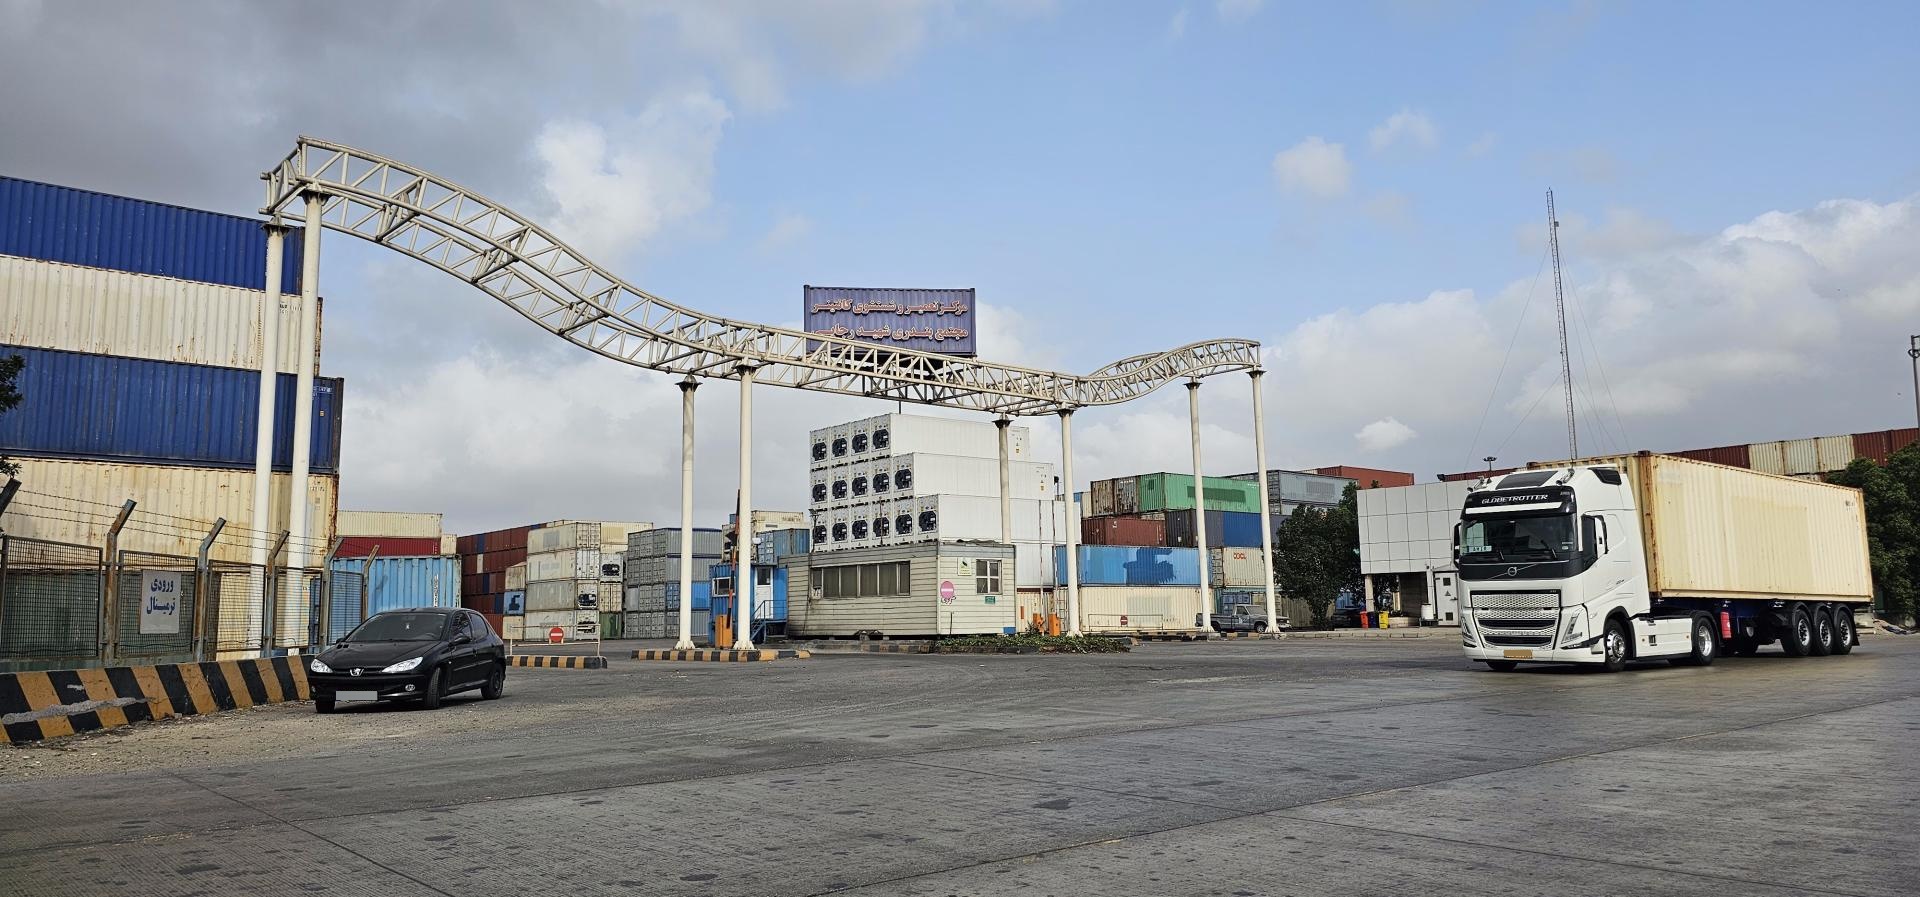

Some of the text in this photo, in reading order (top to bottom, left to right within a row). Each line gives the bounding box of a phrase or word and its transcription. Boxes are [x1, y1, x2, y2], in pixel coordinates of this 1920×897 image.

[811, 299, 968, 316] مرکز تعمیر و شستشوی کانتینر
[811, 323, 968, 341] مجتمع بندری شهید رجای
[1482, 495, 1548, 504] GLOBETROTTER
[150, 578, 174, 593] ورودی
[146, 596, 176, 615] ترمینال
